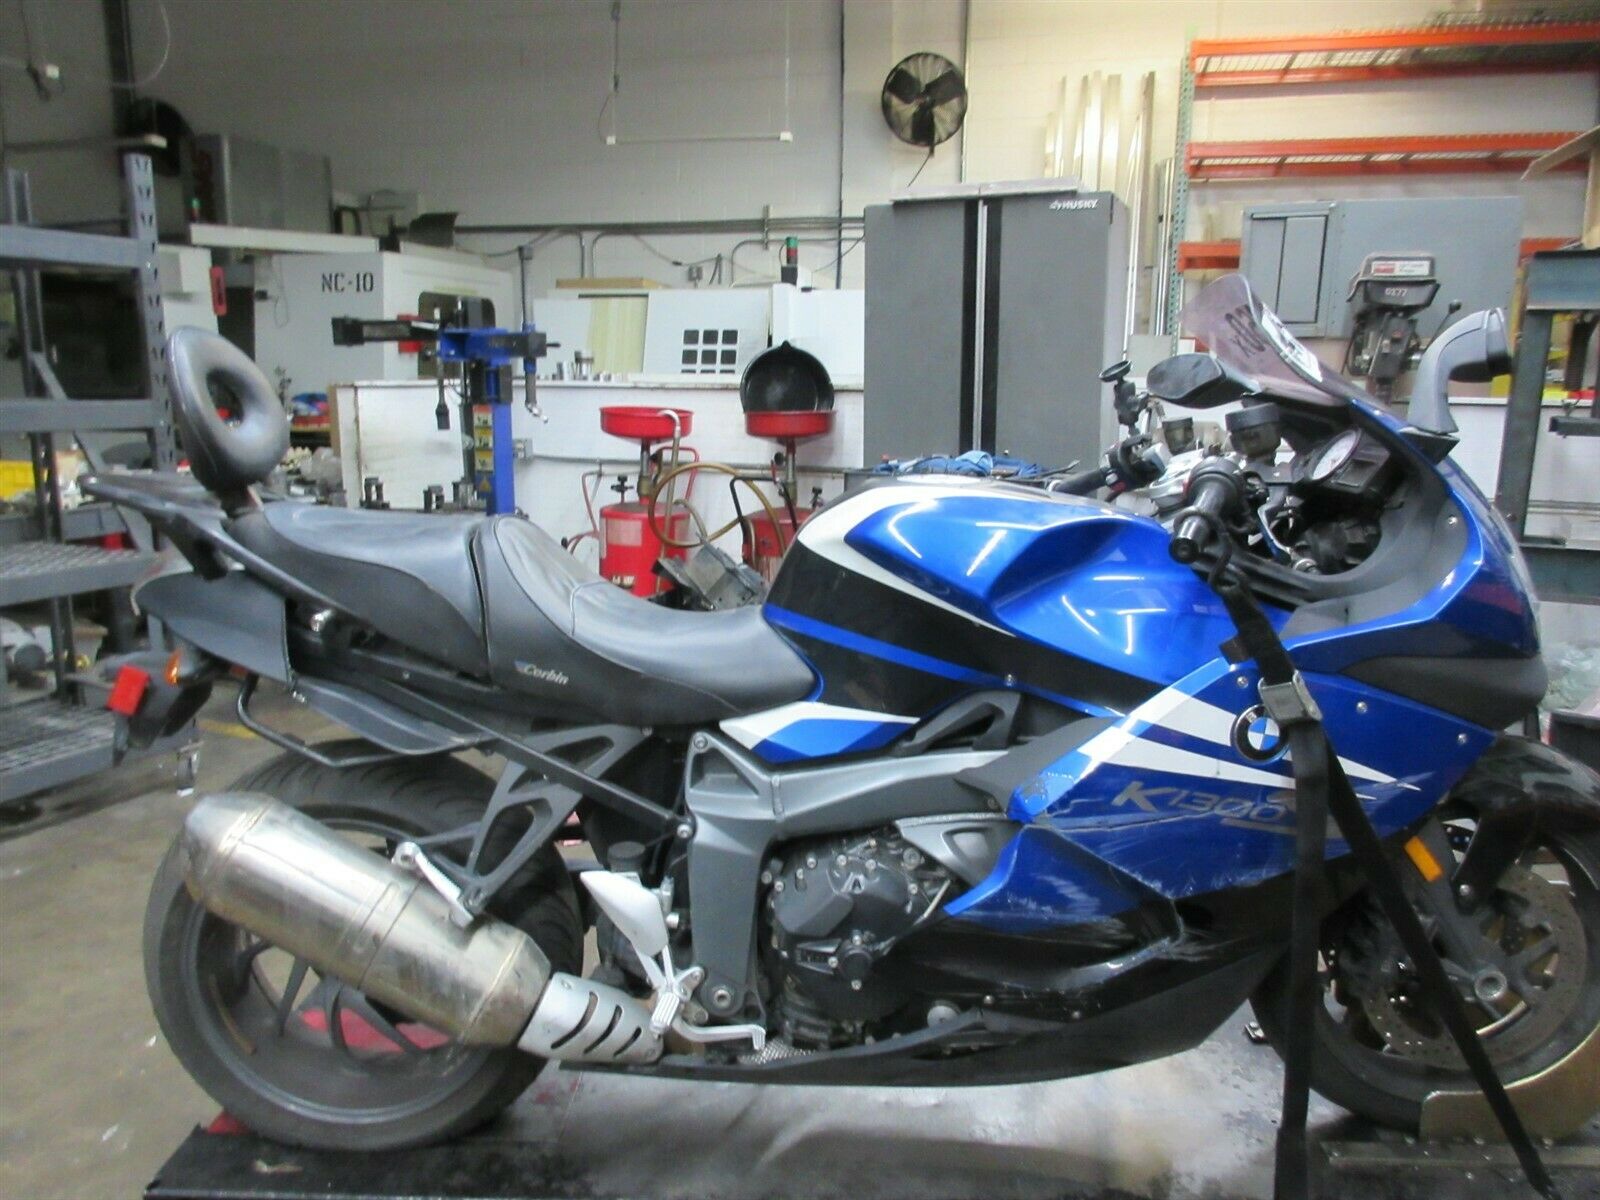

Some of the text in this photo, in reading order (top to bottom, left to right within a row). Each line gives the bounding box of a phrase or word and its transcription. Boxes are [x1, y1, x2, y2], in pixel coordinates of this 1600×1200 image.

[1062, 200, 1098, 209] HUSKY
[321, 272, 374, 292] NC-10
[524, 664, 569, 685] Corbin
